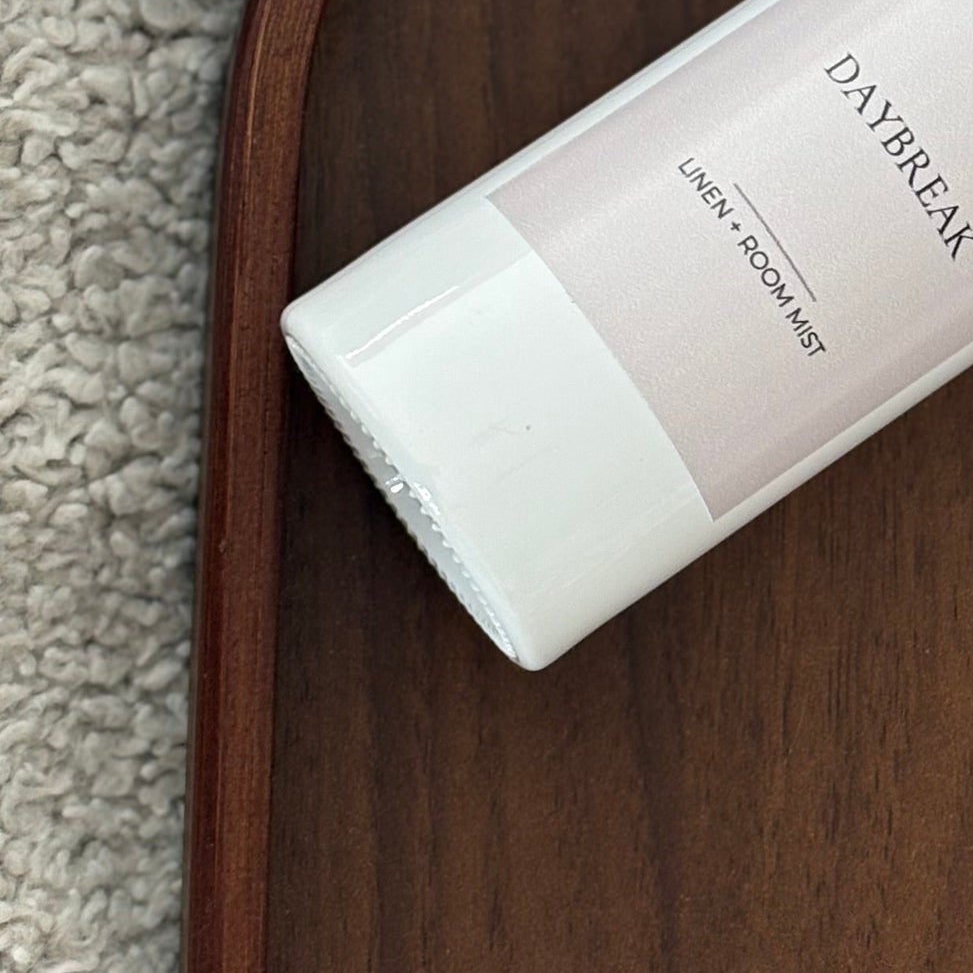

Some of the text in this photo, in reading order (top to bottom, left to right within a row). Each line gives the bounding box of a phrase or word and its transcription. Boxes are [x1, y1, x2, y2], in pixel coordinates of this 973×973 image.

[677, 157, 734, 219] LINEN
[737, 234, 795, 308] ROOM
[785, 307, 826, 357] MIST
